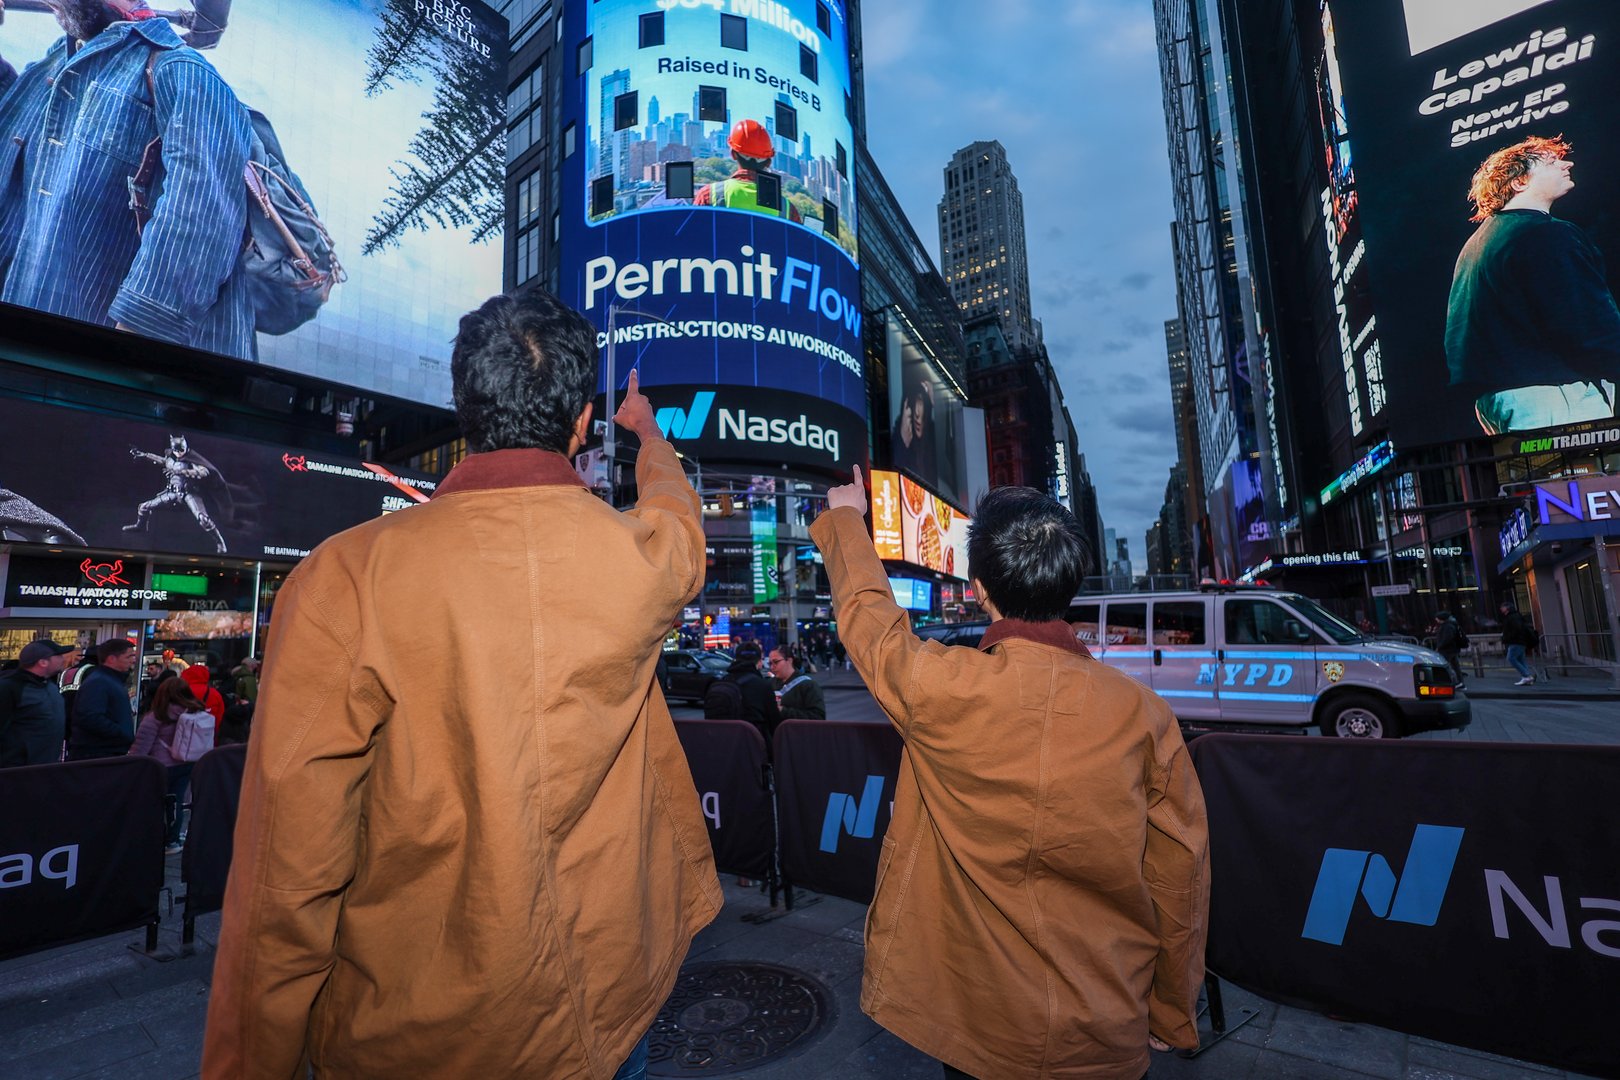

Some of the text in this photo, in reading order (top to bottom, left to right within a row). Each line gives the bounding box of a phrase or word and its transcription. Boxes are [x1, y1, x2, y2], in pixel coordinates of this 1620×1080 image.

[414, 0, 491, 58] PICTURE
[433, 0, 476, 35] BEST
[1418, 34, 1596, 116] Capaldi
[1432, 26, 1567, 91] Lewis
[657, 57, 821, 112] Raised in Series B
[1450, 83, 1566, 133] New EP
[1450, 101, 1570, 148] Survive
[1320, 186, 1341, 281] NOW
[596, 320, 862, 378] CONSTRUCTION'S AI WORKFORCE
[1333, 277, 1363, 437] RESERVE
[718, 408, 840, 462] Nasdaq
[416, 479, 436, 491] YORK
[264, 545, 275, 555] THE
[276, 547, 300, 557] BATMAN
[1283, 551, 1360, 566] opening this fall
[19, 585, 168, 601] TAMASHII NATIONS STORE
[64, 597, 128, 607] NEW YORK
[1195, 663, 1293, 687] NYPD
